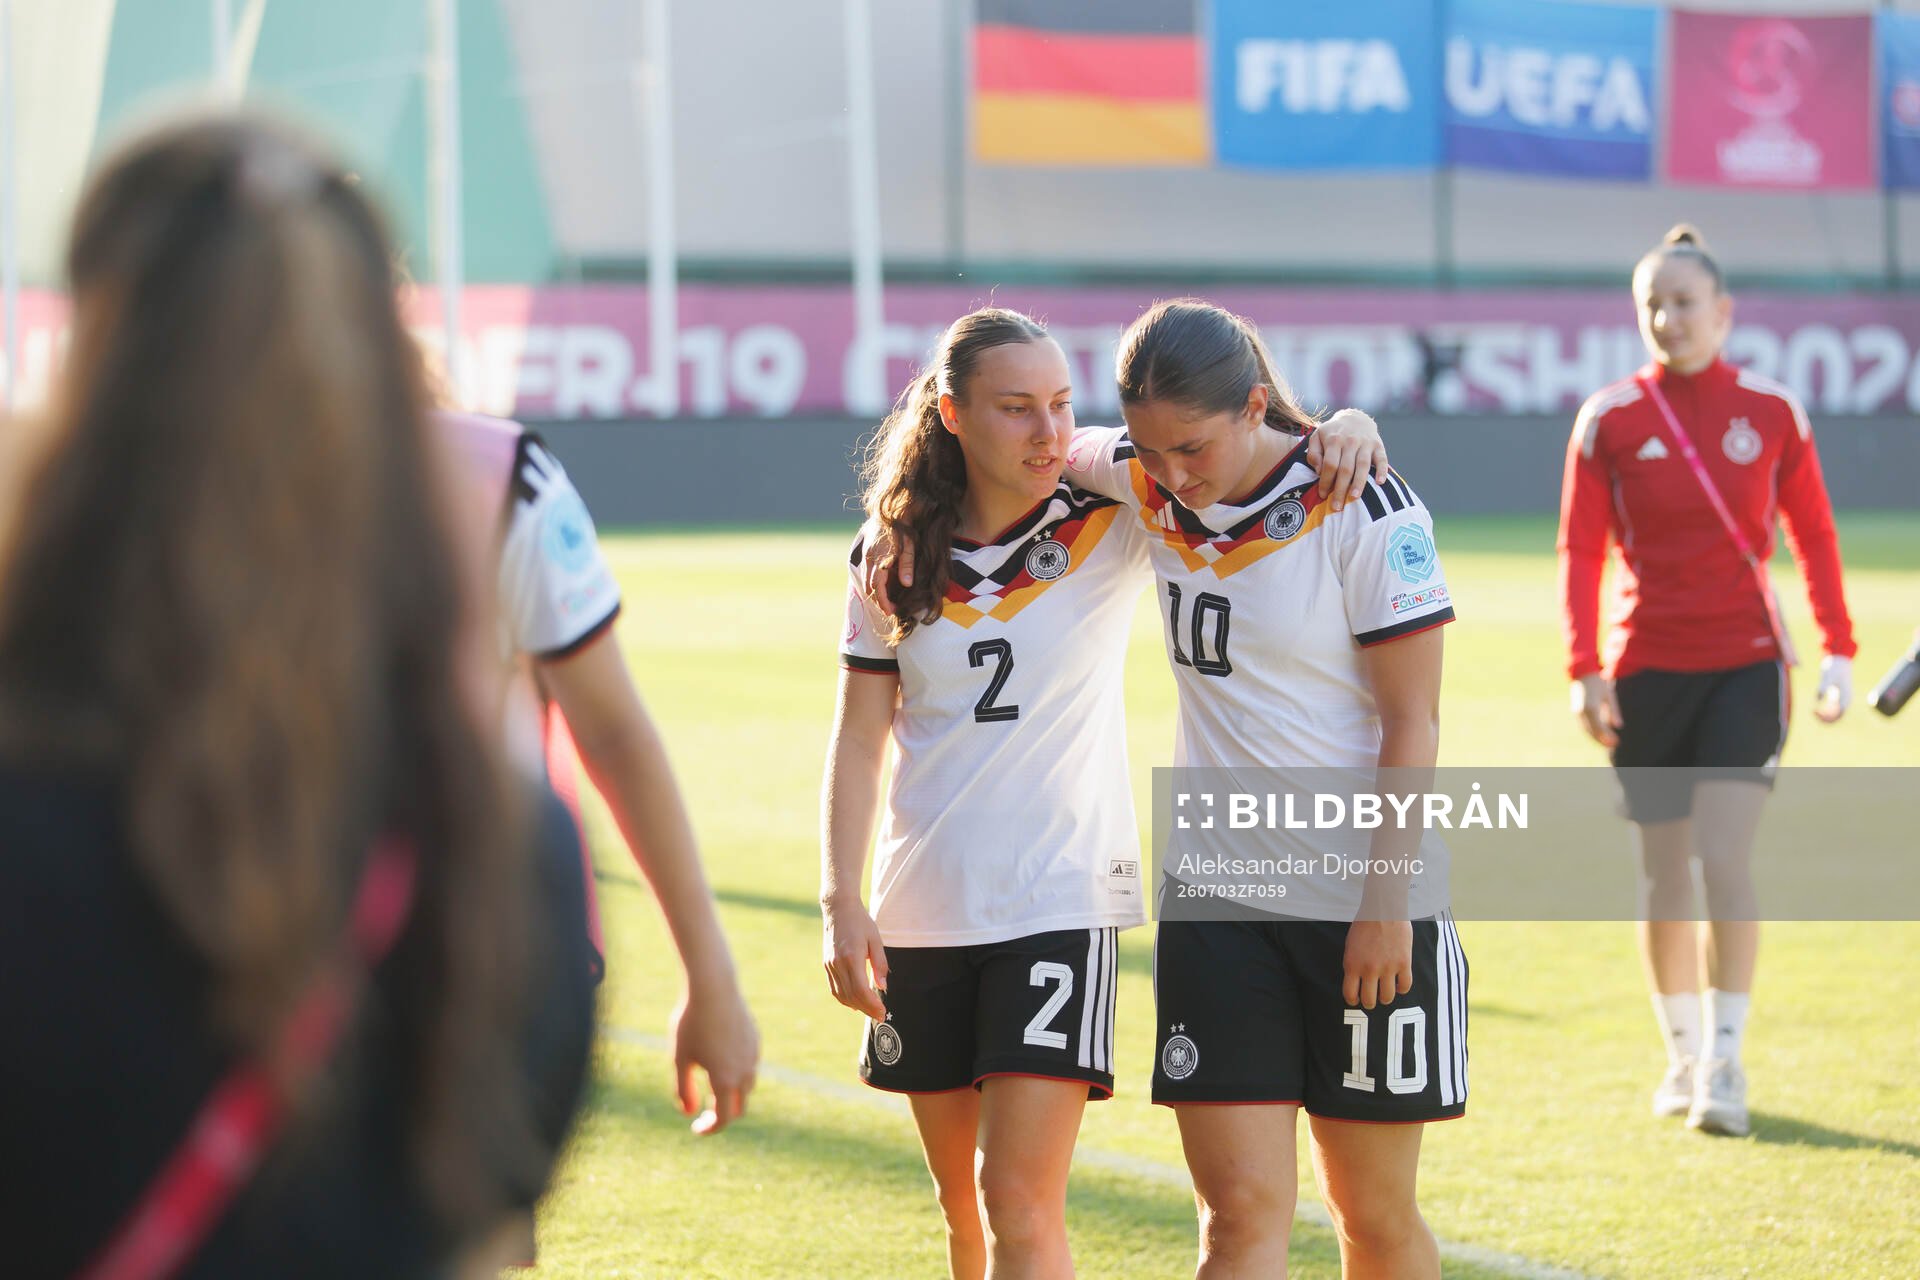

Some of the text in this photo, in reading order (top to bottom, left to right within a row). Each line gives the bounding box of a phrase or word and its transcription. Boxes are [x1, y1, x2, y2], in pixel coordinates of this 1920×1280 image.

[1236, 38, 1410, 113] FIFA
[1446, 36, 1649, 133] UEFA
[1405, 555, 1426, 566] Strong
[1167, 581, 1233, 677] 10
[967, 637, 1019, 723] 2
[1023, 961, 1075, 1049] 2
[1343, 1006, 1428, 1095] 10
